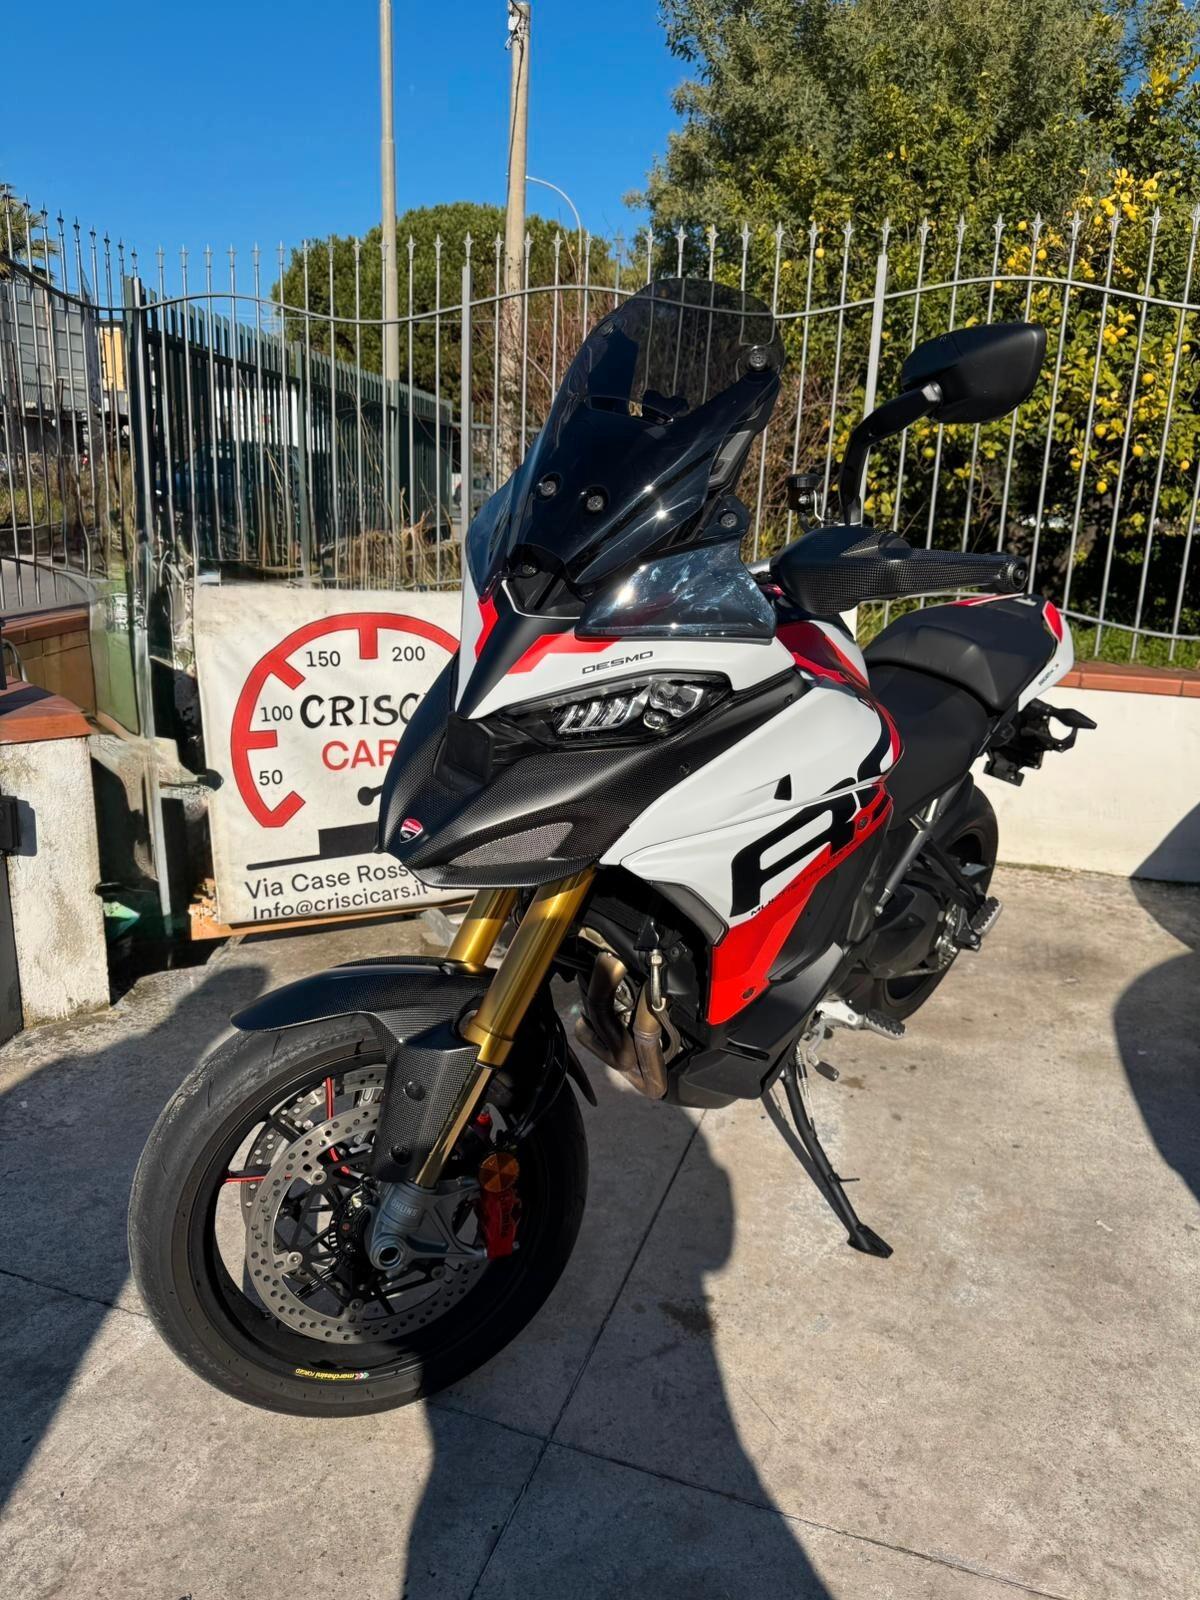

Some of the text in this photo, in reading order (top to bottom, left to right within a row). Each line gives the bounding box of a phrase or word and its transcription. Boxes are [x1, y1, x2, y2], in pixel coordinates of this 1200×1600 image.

[305, 650, 341, 668] 150
[392, 646, 426, 663] 200
[581, 650, 654, 674] DESMO
[260, 705, 293, 722] 100
[300, 692, 427, 729] CRISC
[258, 769, 283, 786] 50
[245, 878, 284, 899] Via
[291, 871, 350, 892] Case
[252, 880, 428, 920] Info@criscicars.it
